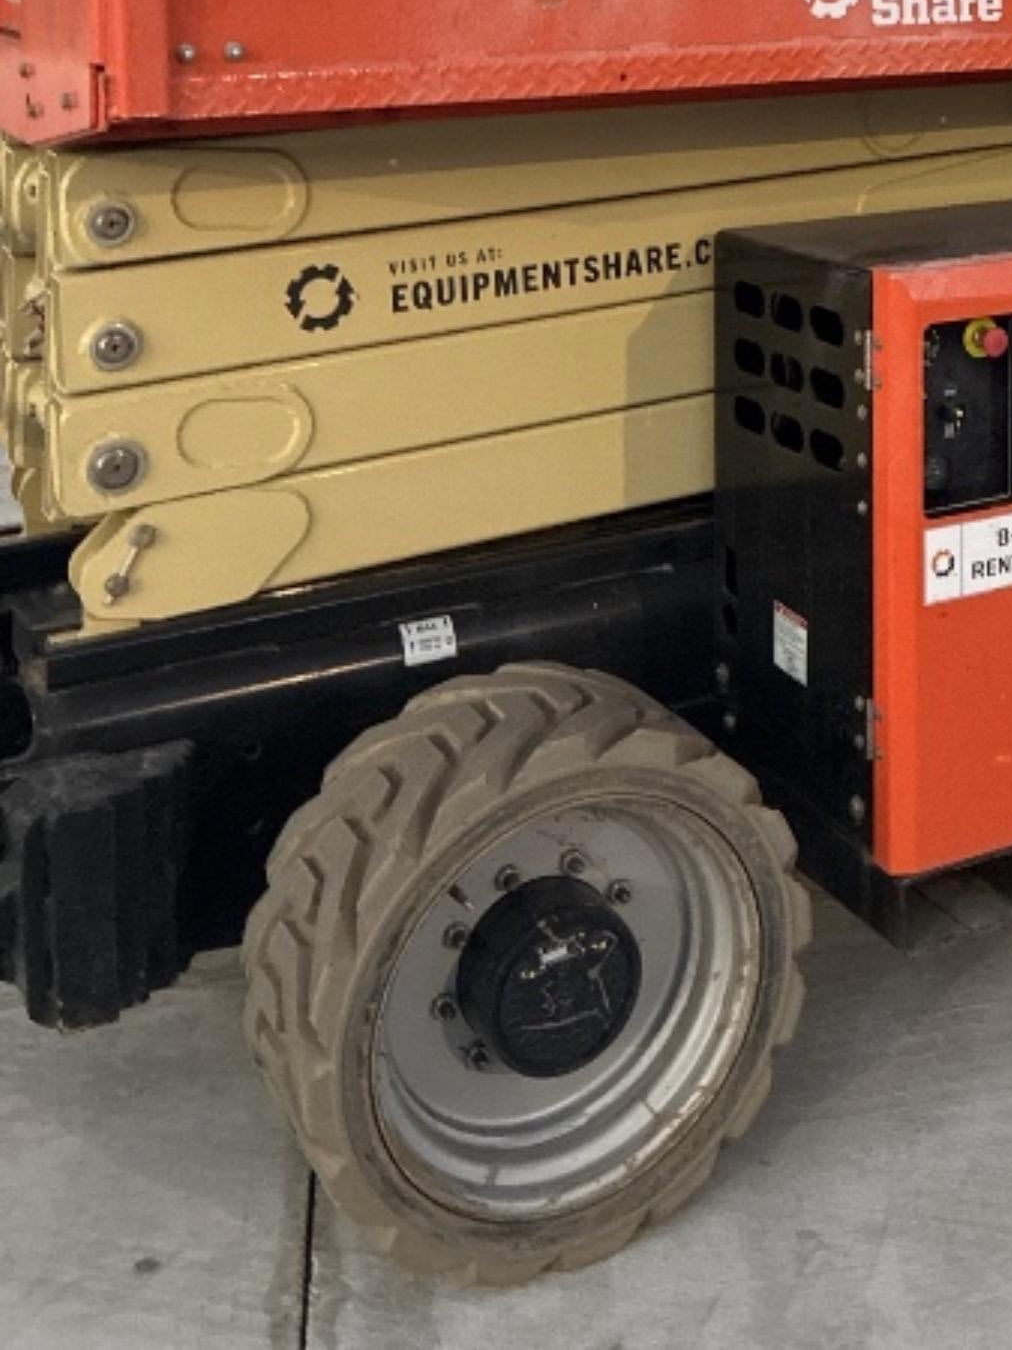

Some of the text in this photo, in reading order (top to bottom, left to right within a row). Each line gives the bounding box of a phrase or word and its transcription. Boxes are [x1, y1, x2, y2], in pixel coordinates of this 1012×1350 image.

[388, 254, 436, 276] VISIT
[446, 252, 469, 267] US
[391, 239, 712, 313] EQUIPMENTSHARE.C
